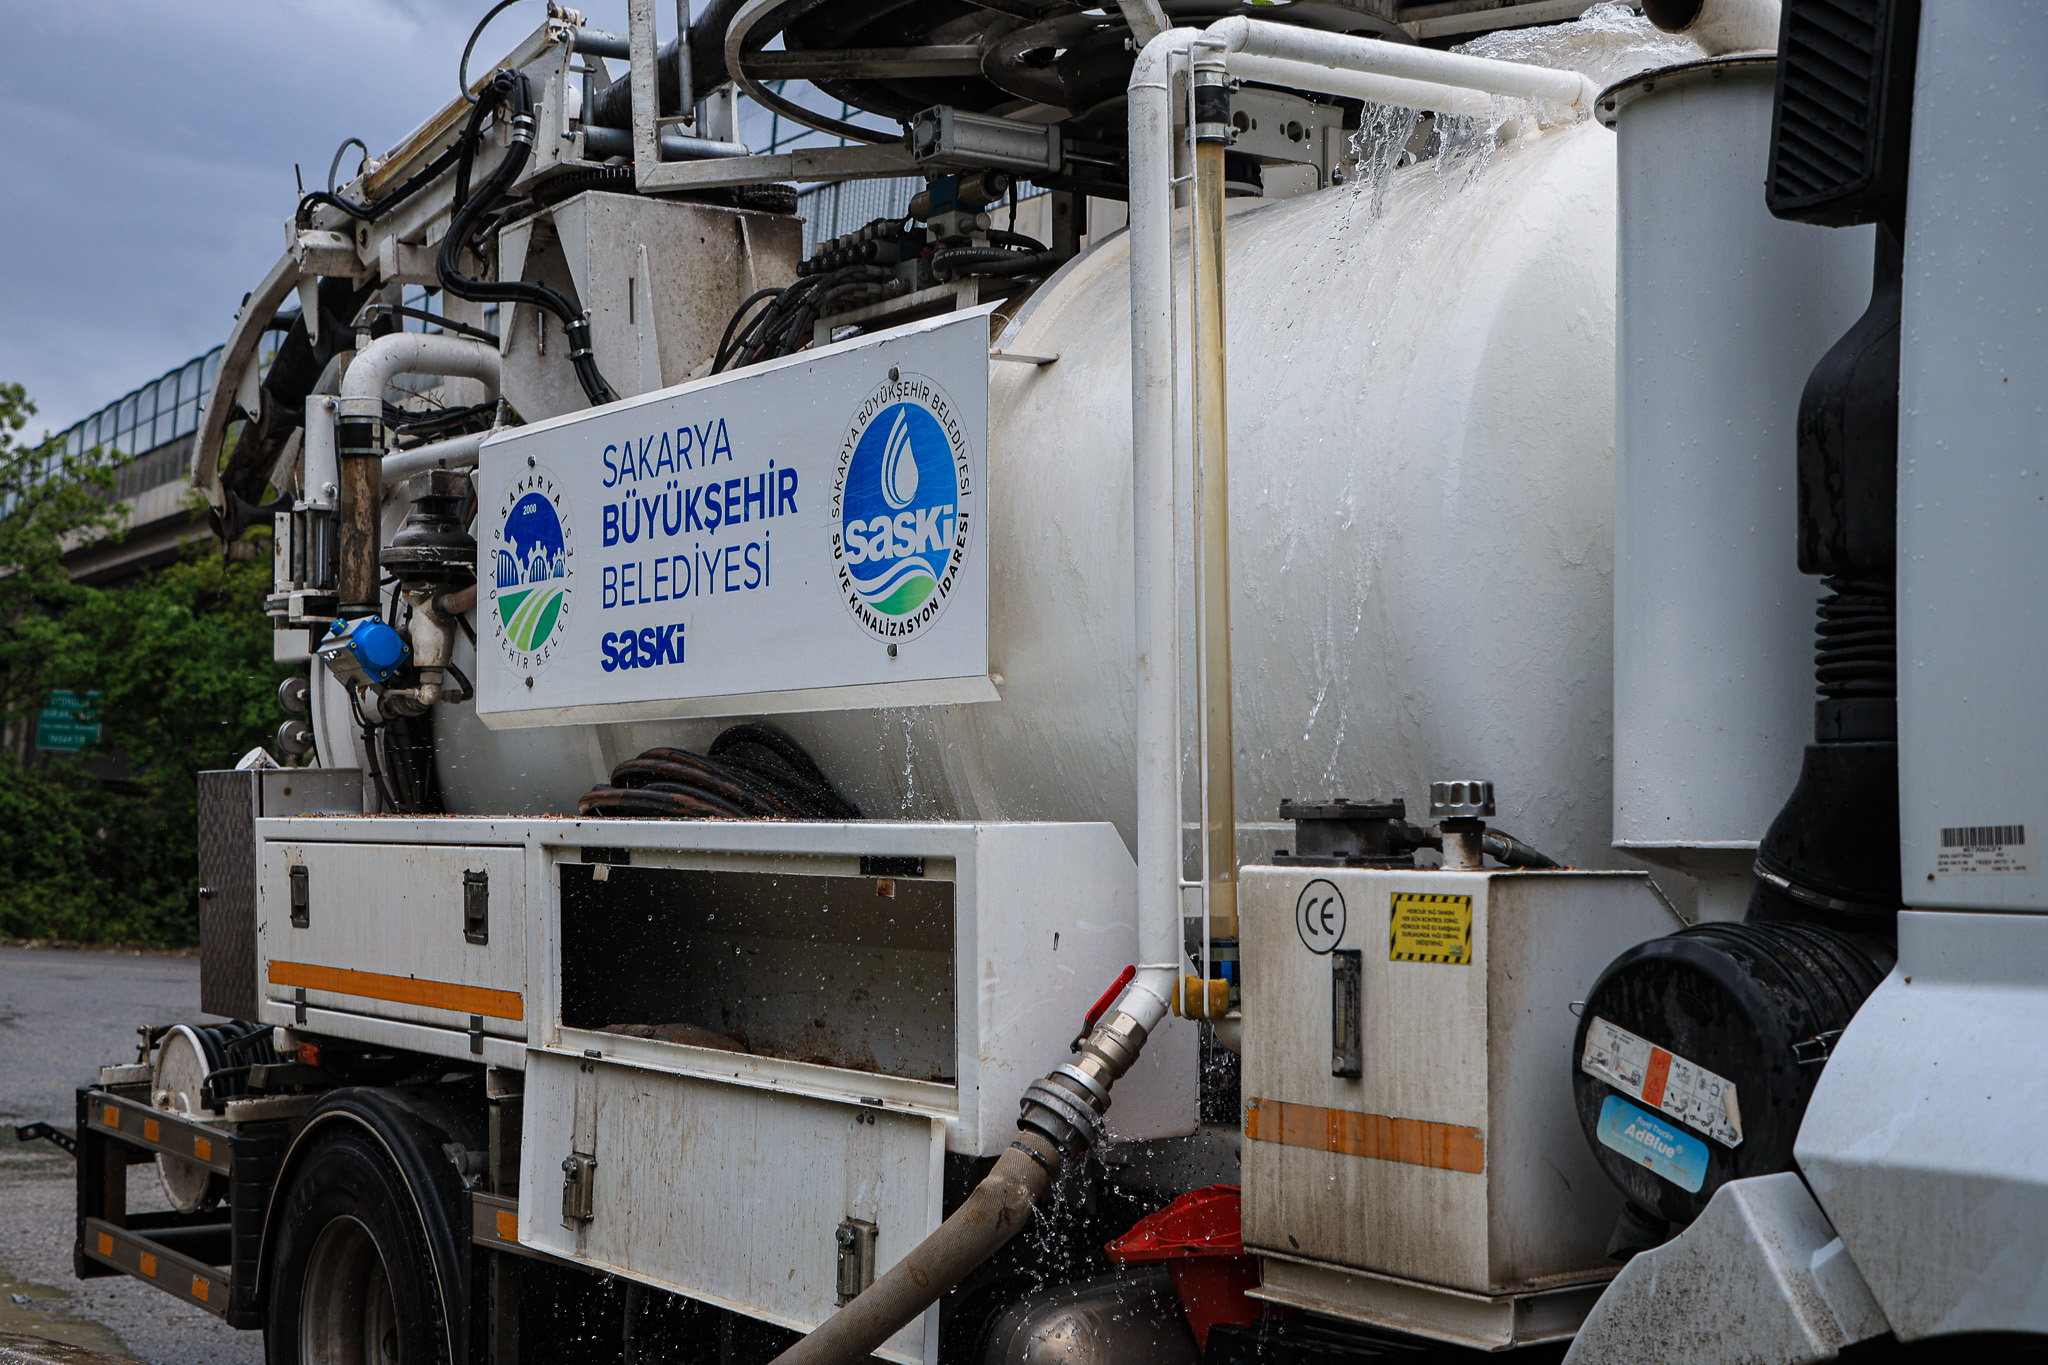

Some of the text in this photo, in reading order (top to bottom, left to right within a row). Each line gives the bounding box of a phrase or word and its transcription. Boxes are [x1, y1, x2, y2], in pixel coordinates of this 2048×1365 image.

[602, 418, 733, 488] SAKARYA
[832, 380, 971, 518] SAKARYA BÜYÜKŞEHİR BELEDİYESİ
[501, 475, 560, 519] SAKARYA
[522, 503, 537, 516] 2000
[602, 458, 799, 548] BÜYÜKŞEHİR
[602, 529, 770, 610] BELEDİYESİ
[832, 512, 969, 636] SU VE KANALİZASYON İDARESİ
[1305, 897, 1333, 935] CE
[1636, 1116, 1674, 1141] Ford Trucks
